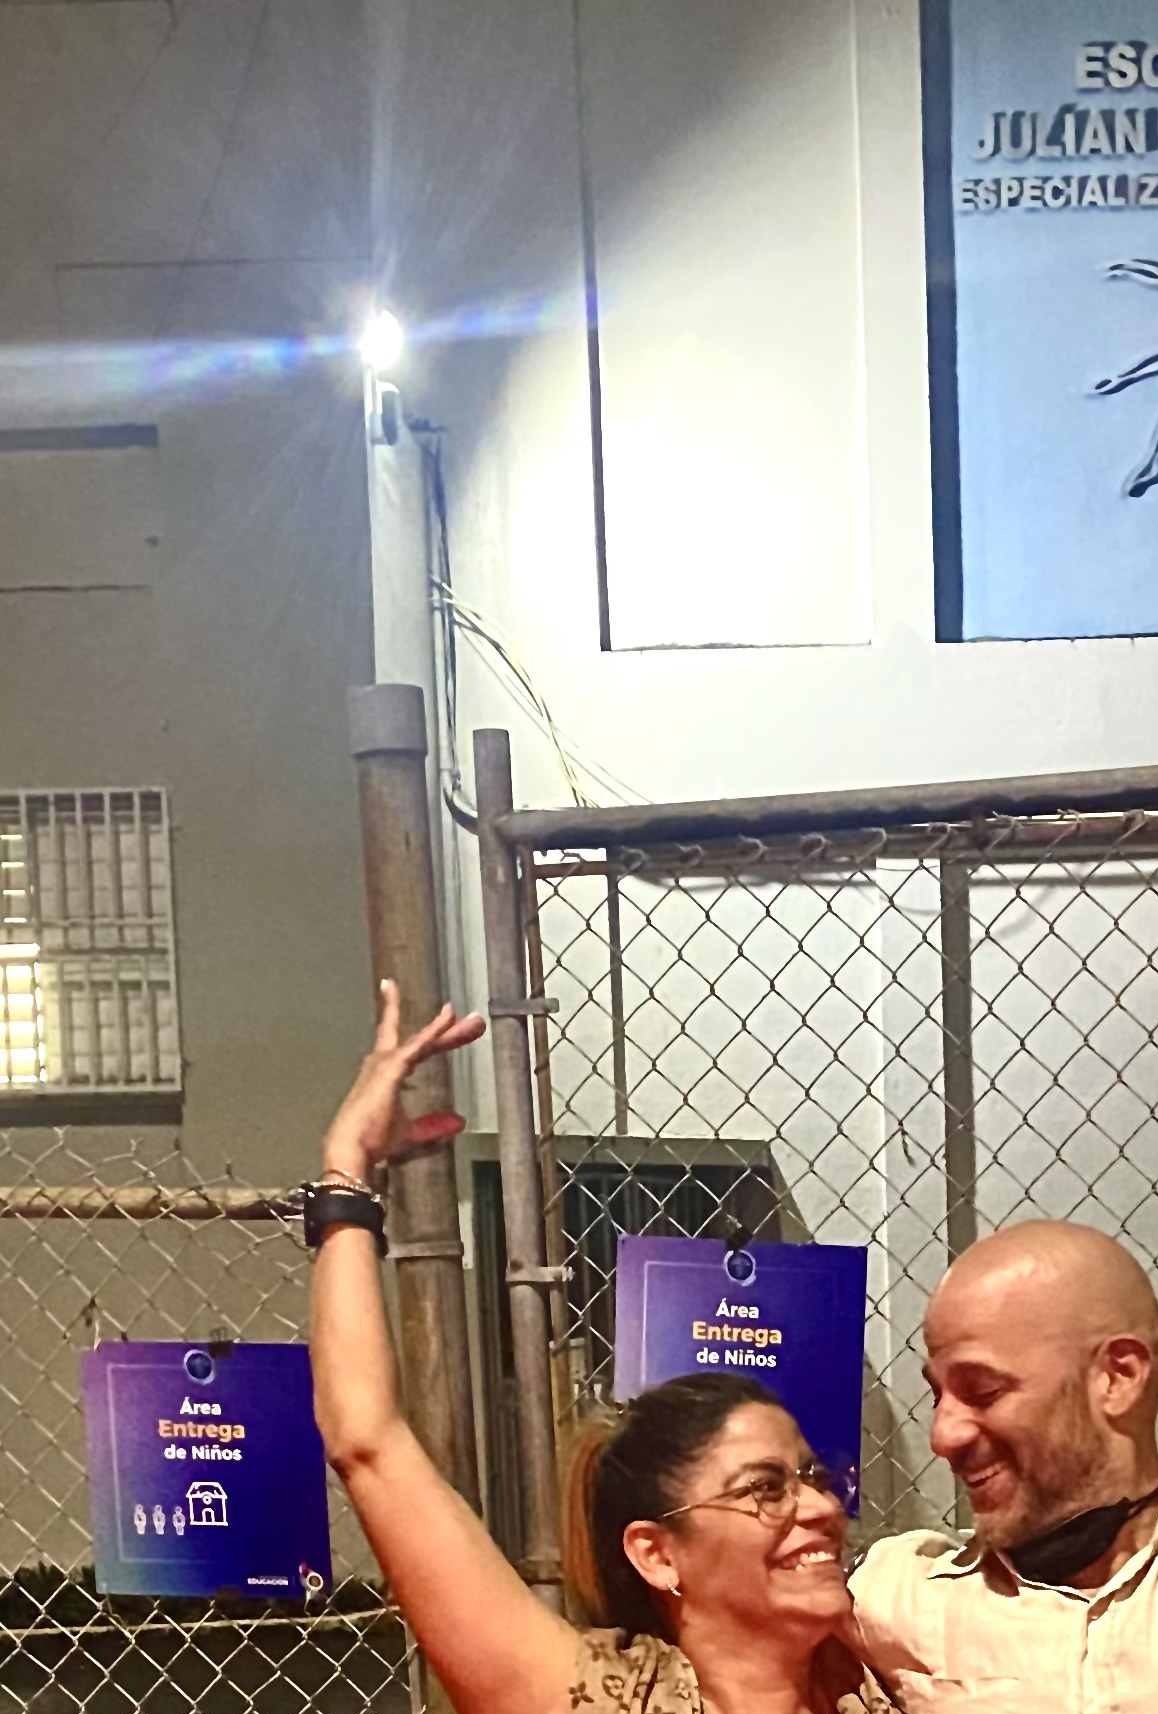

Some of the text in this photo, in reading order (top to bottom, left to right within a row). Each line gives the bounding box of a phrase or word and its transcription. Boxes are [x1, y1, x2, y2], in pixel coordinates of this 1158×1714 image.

[715, 1297, 760, 1319] Área
[692, 1320, 783, 1347] Entrega
[696, 1347, 777, 1368] de Niños
[179, 1396, 222, 1416] Área
[158, 1418, 246, 1442] Entrega
[163, 1443, 243, 1461] de Niños
